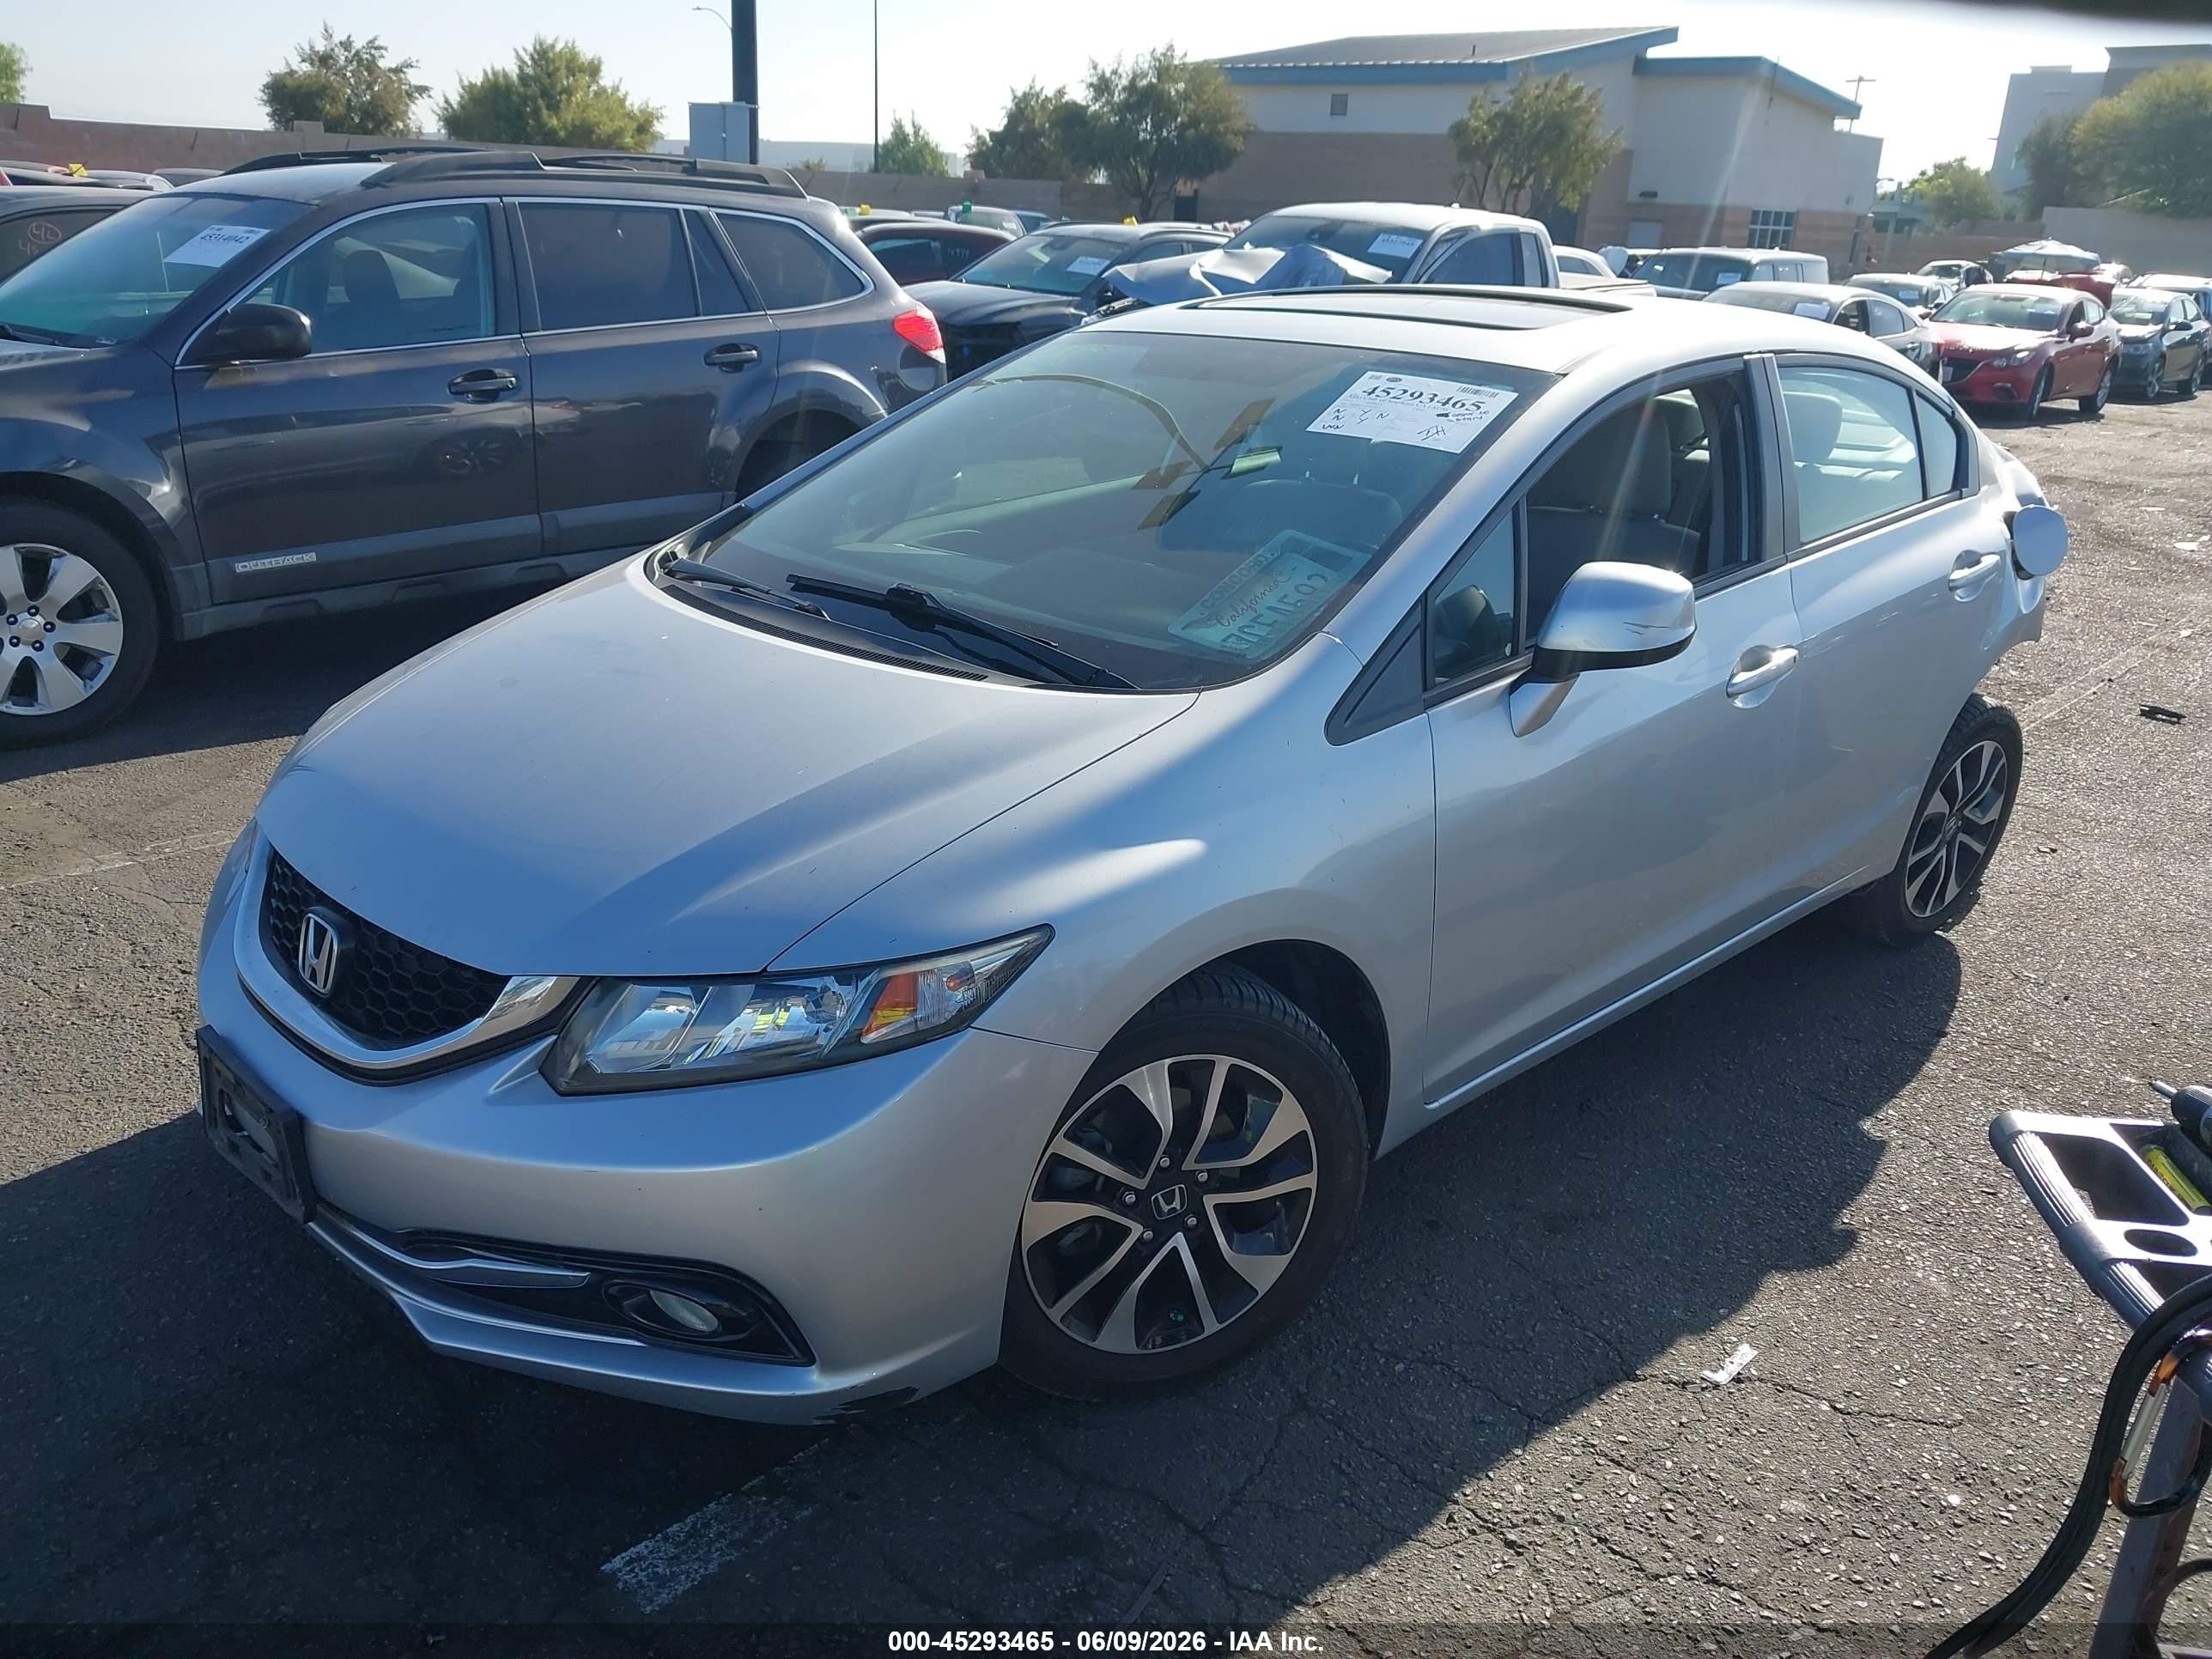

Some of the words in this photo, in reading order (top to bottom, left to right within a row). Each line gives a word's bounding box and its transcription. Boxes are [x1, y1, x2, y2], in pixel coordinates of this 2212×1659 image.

[1362, 386, 1486, 412] 45293465
[236, 553, 316, 572] OUTBACK
[1215, 574, 1291, 628] California
